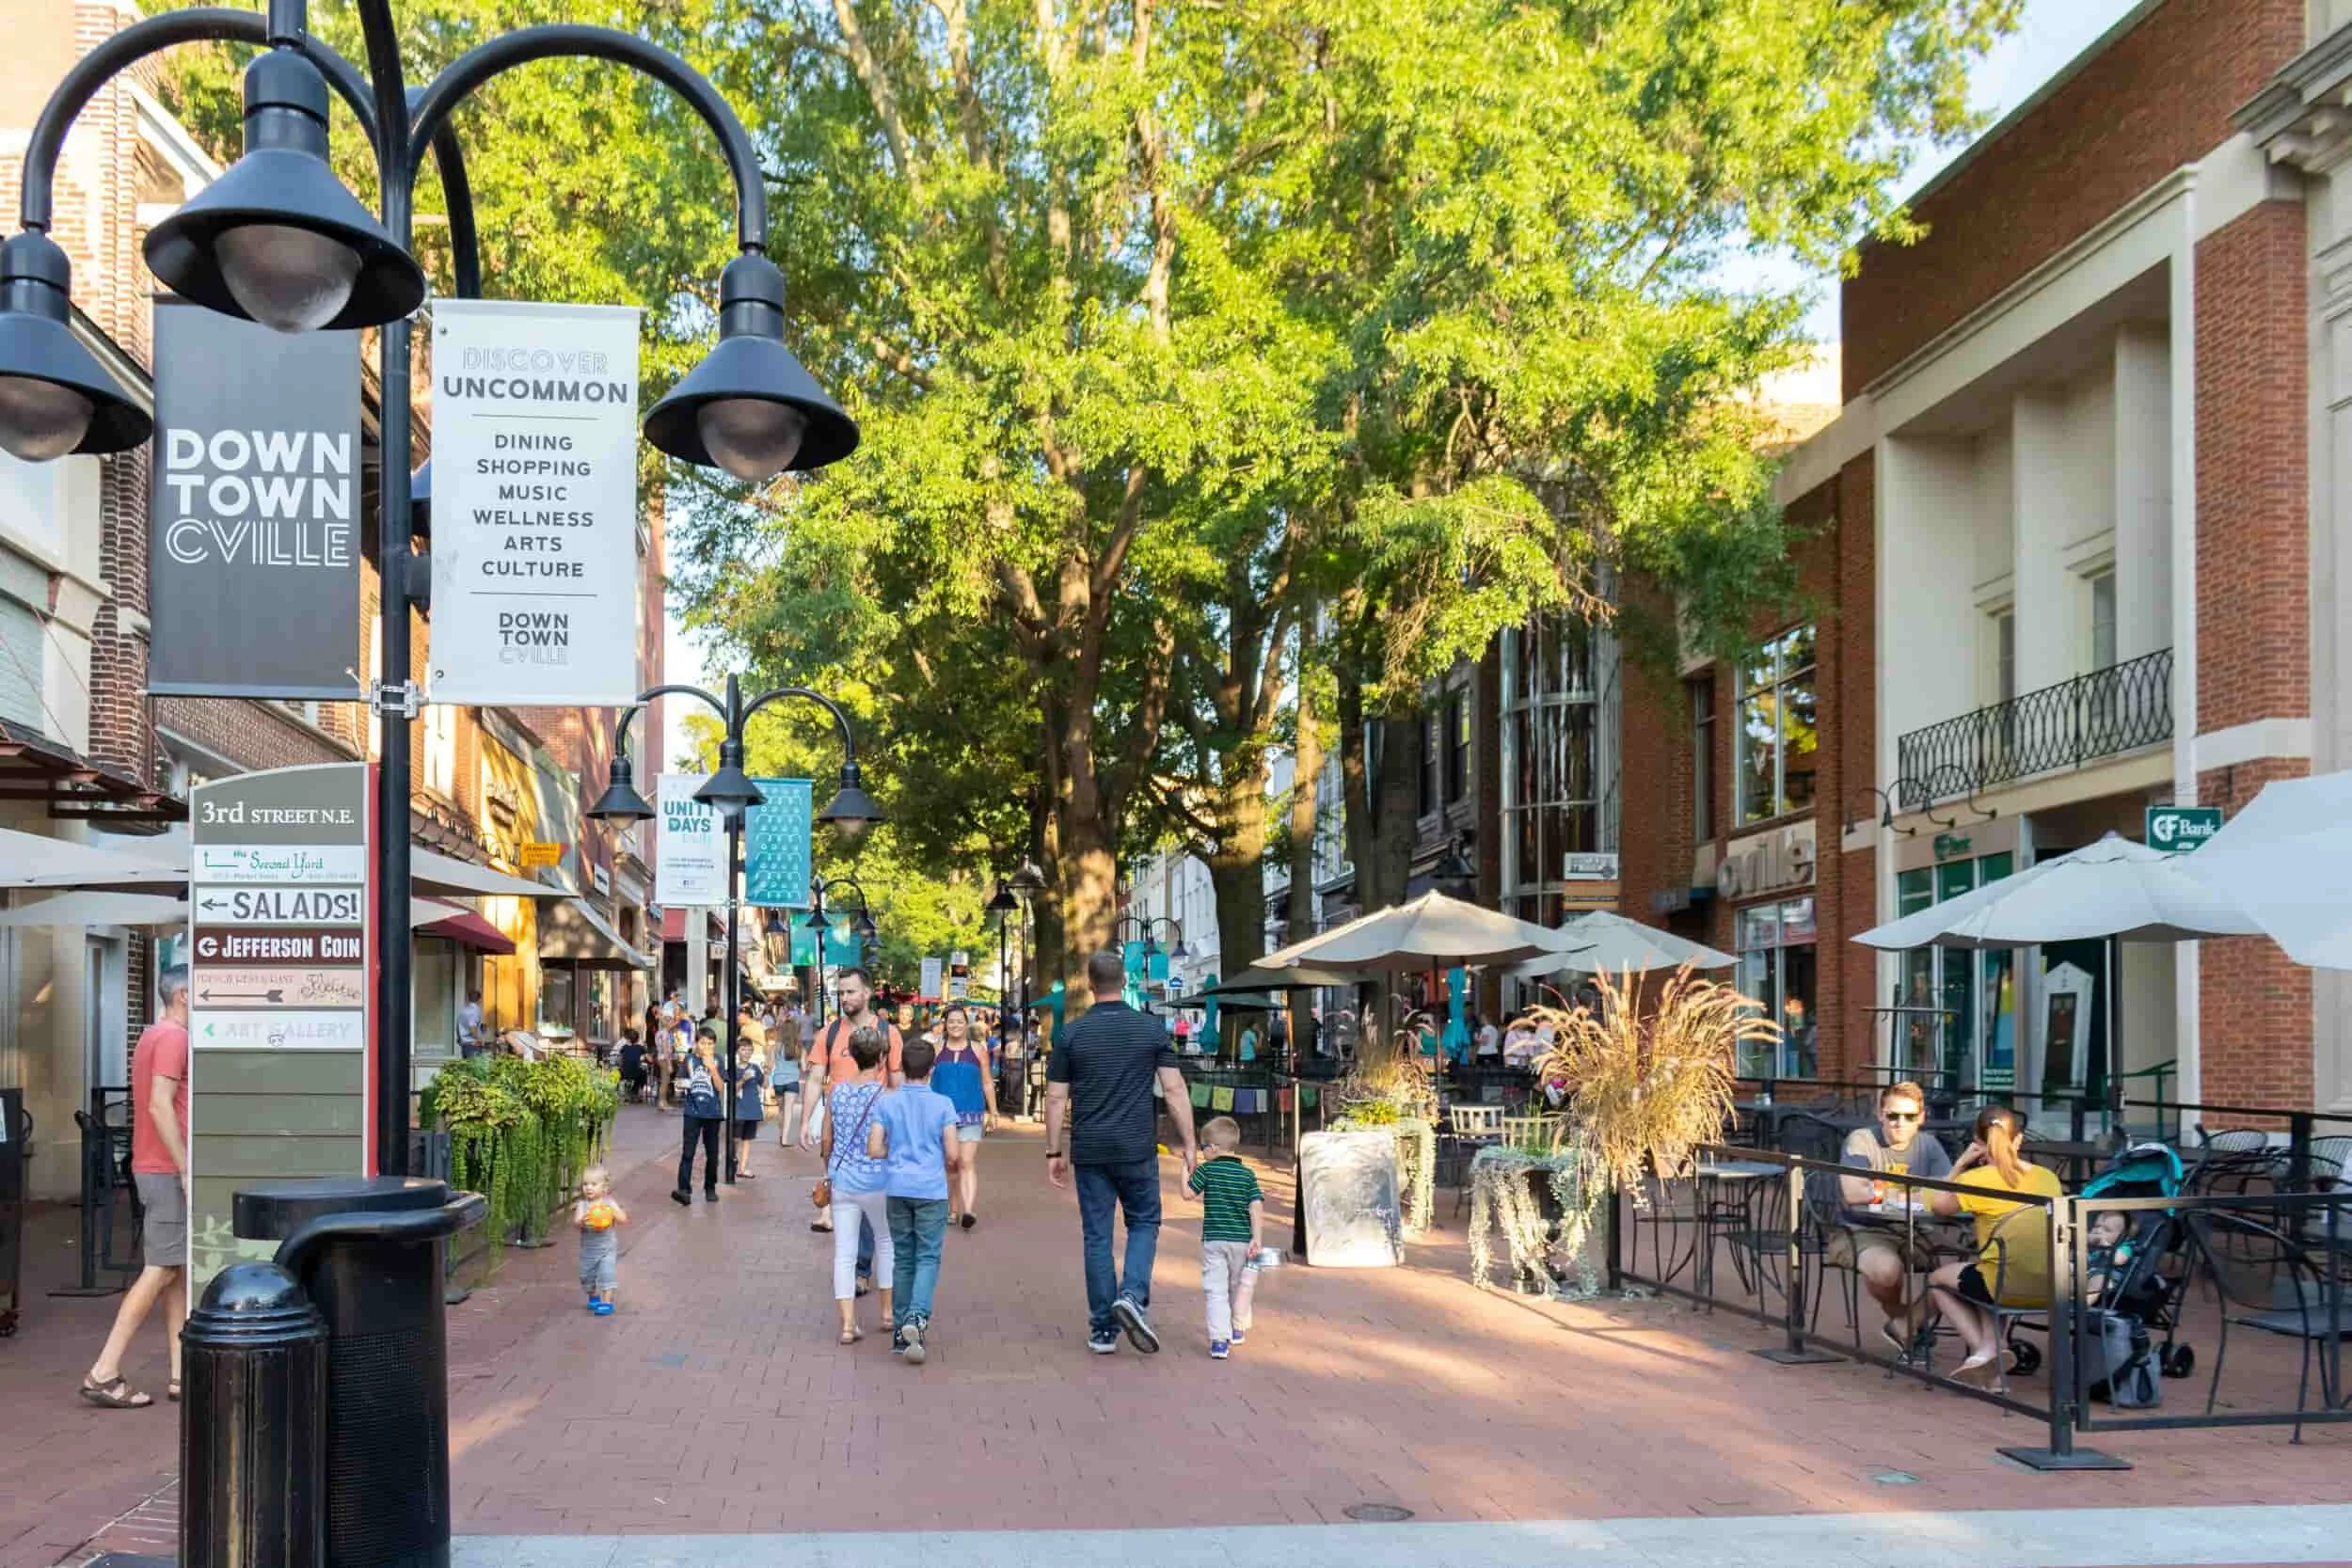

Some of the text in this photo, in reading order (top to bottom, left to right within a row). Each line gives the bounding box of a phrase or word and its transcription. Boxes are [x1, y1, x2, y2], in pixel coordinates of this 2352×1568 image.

[462, 346, 610, 374] DISCOVER
[442, 376, 628, 404] UNCOMMON
[167, 429, 351, 474] DOWN
[494, 434, 574, 451] DINING
[476, 458, 592, 477] SHOPPING
[167, 474, 351, 520] TOWN
[498, 484, 568, 501] MUSIC
[473, 509, 595, 528] WELLNESS
[165, 519, 351, 567] CVILLE
[503, 535, 564, 552] ARTS
[481, 561, 584, 578] CULTURE
[498, 612, 569, 628] DOWN
[498, 630, 569, 646] TOWN
[201, 801, 355, 825] 3rd STREET N.E.
[664, 800, 715, 816] UNITY
[668, 816, 712, 832] DAYS
[2179, 818, 2215, 836] Bank
[250, 850, 291, 870] Second
[293, 850, 325, 879] Yard
[232, 892, 359, 921] SALADS!
[222, 934, 360, 958] JEFFERSON COIN
